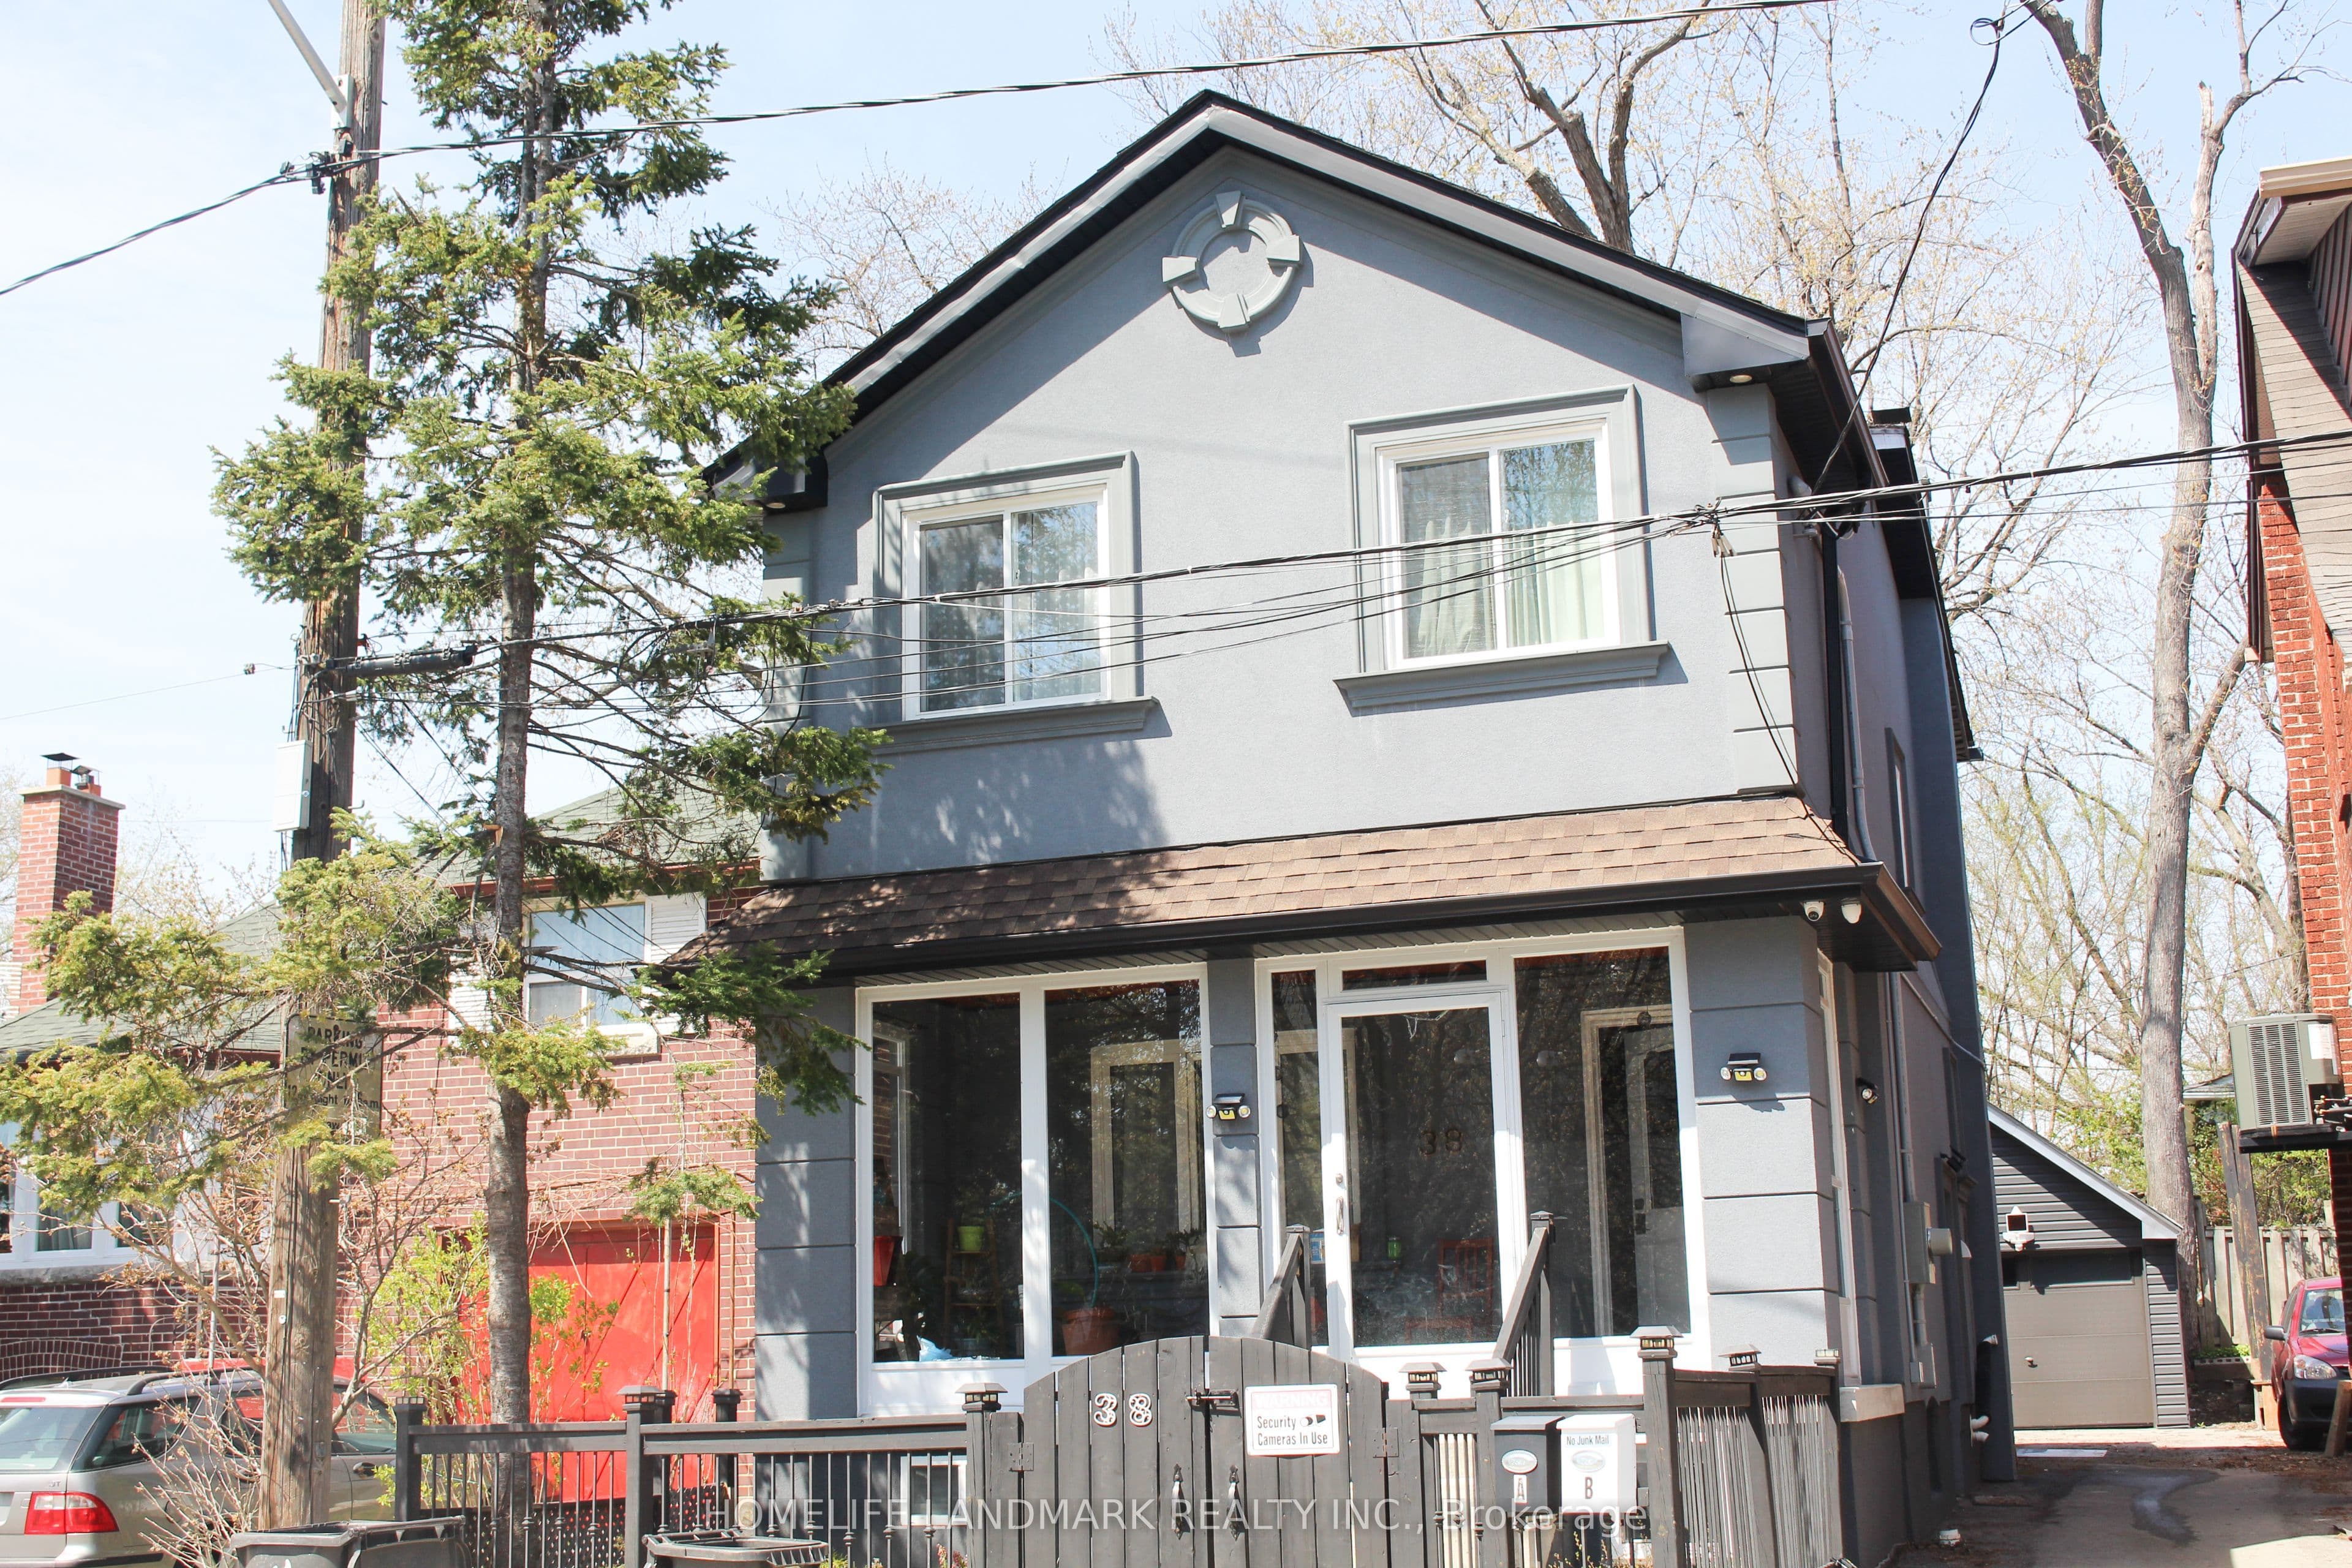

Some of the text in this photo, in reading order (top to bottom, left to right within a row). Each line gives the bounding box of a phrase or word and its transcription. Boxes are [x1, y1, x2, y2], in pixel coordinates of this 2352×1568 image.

[323, 1050, 368, 1067] ERMI
[1093, 1393, 1153, 1427] 38
[1257, 1415, 1296, 1430] Security
[1257, 1431, 1328, 1446] Cameras In Use
[1566, 1434, 1609, 1446] No Junk Mail
[1517, 1477, 1525, 1501] A
[1585, 1477, 1593, 1499] B
